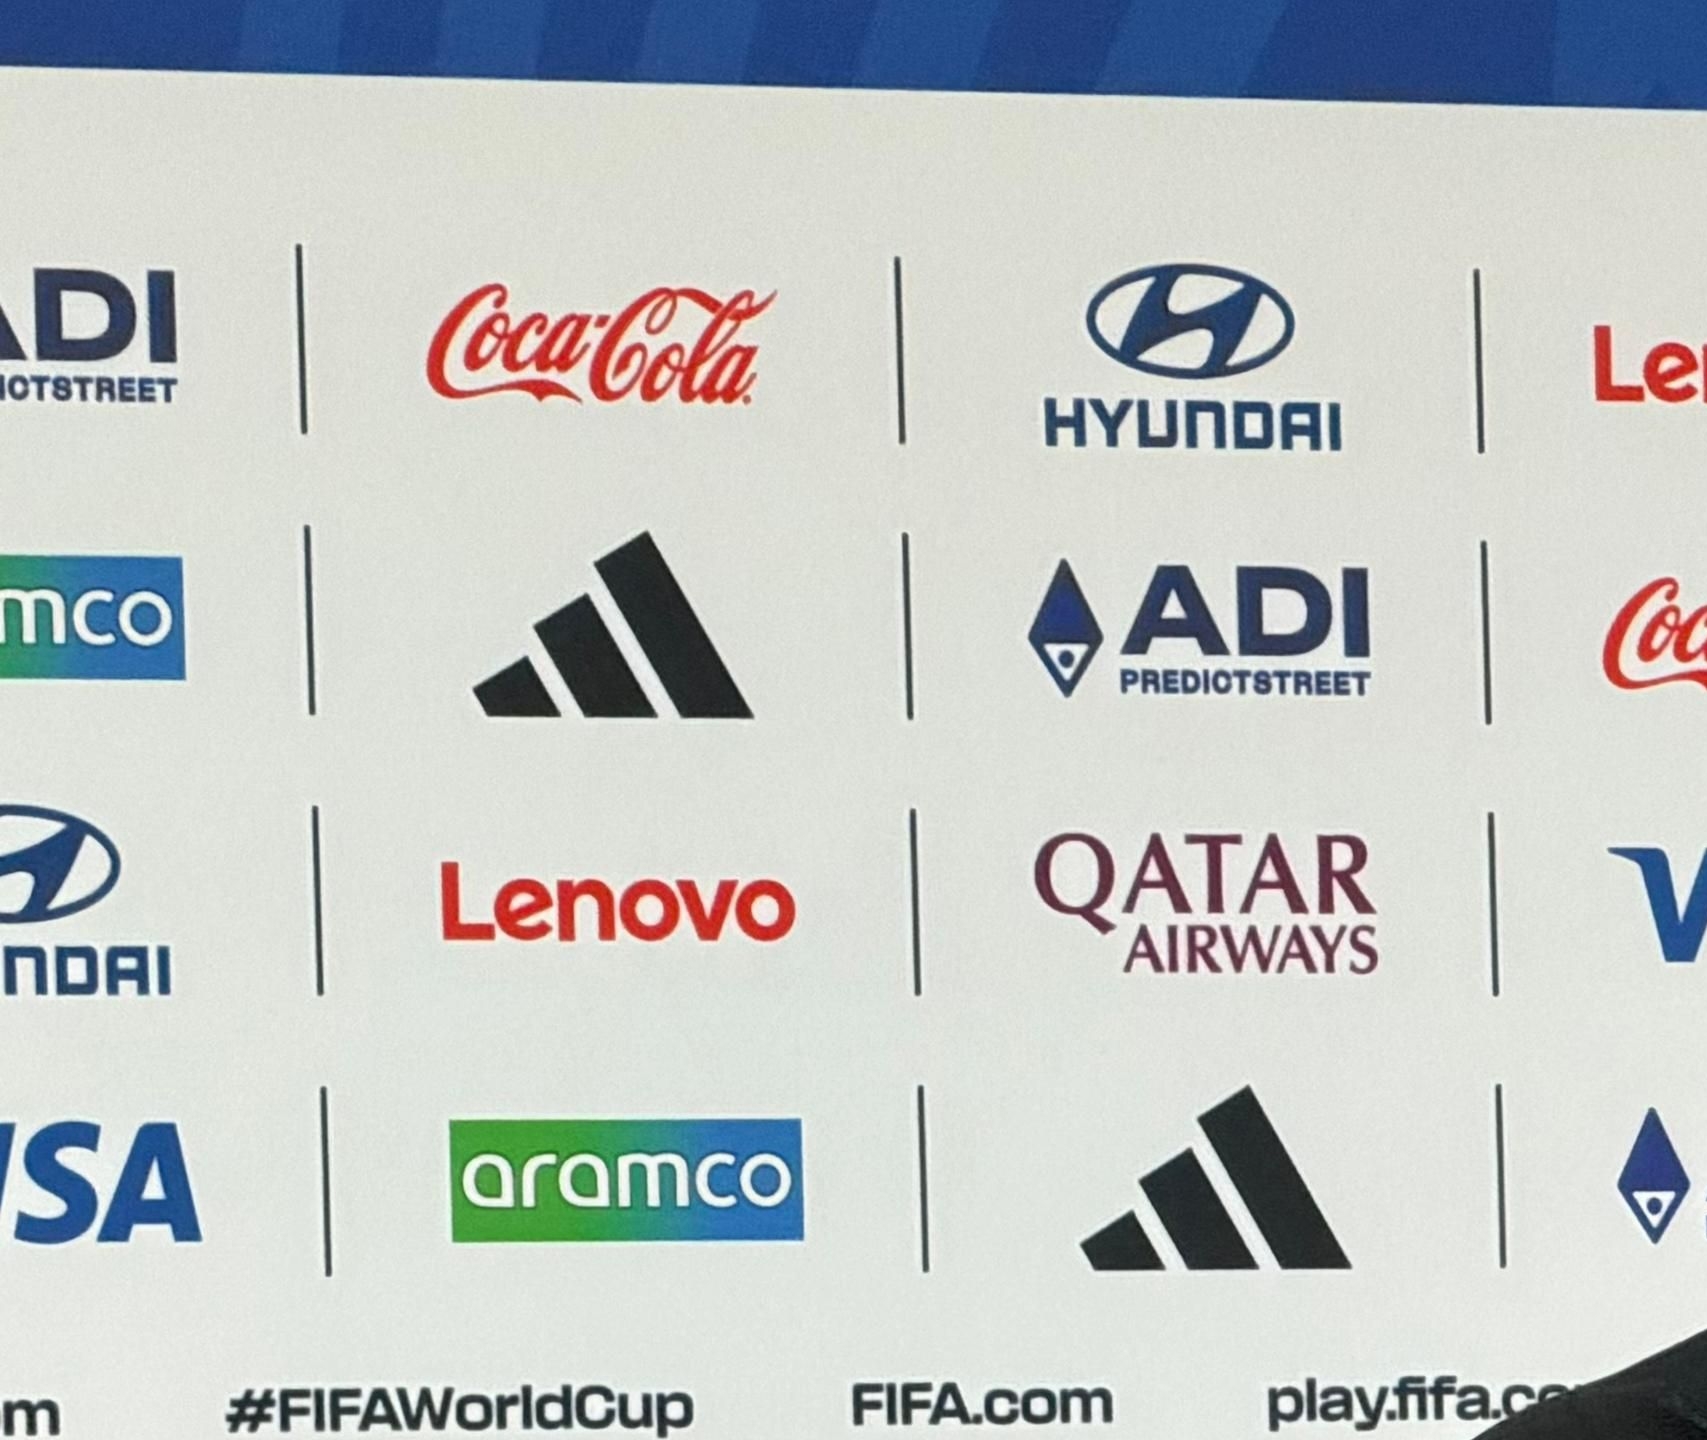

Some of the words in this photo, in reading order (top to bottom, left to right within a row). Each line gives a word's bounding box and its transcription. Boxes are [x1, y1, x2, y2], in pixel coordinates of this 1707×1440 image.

[0, 268, 177, 363] DI
[427, 284, 774, 404] Coca-Cola
[0, 375, 178, 403] ICTSTREET
[1045, 398, 1341, 451] HYUNDAI
[0, 590, 171, 645] mco
[1121, 565, 1370, 657] ADI
[1120, 669, 1371, 696] PREDICTSTREET
[442, 862, 795, 941] Lenovo
[1035, 833, 1376, 942] QATAR
[4, 946, 170, 995] NDAI
[1124, 924, 1378, 974] AIRWAYS
[0, 1121, 202, 1244] SA
[463, 1154, 791, 1207] aramco
[226, 1385, 693, 1438] #FIFAWorldCup
[853, 1382, 1113, 1425] FIFA.com
[1268, 1375, 1583, 1431] play.fifa.c
